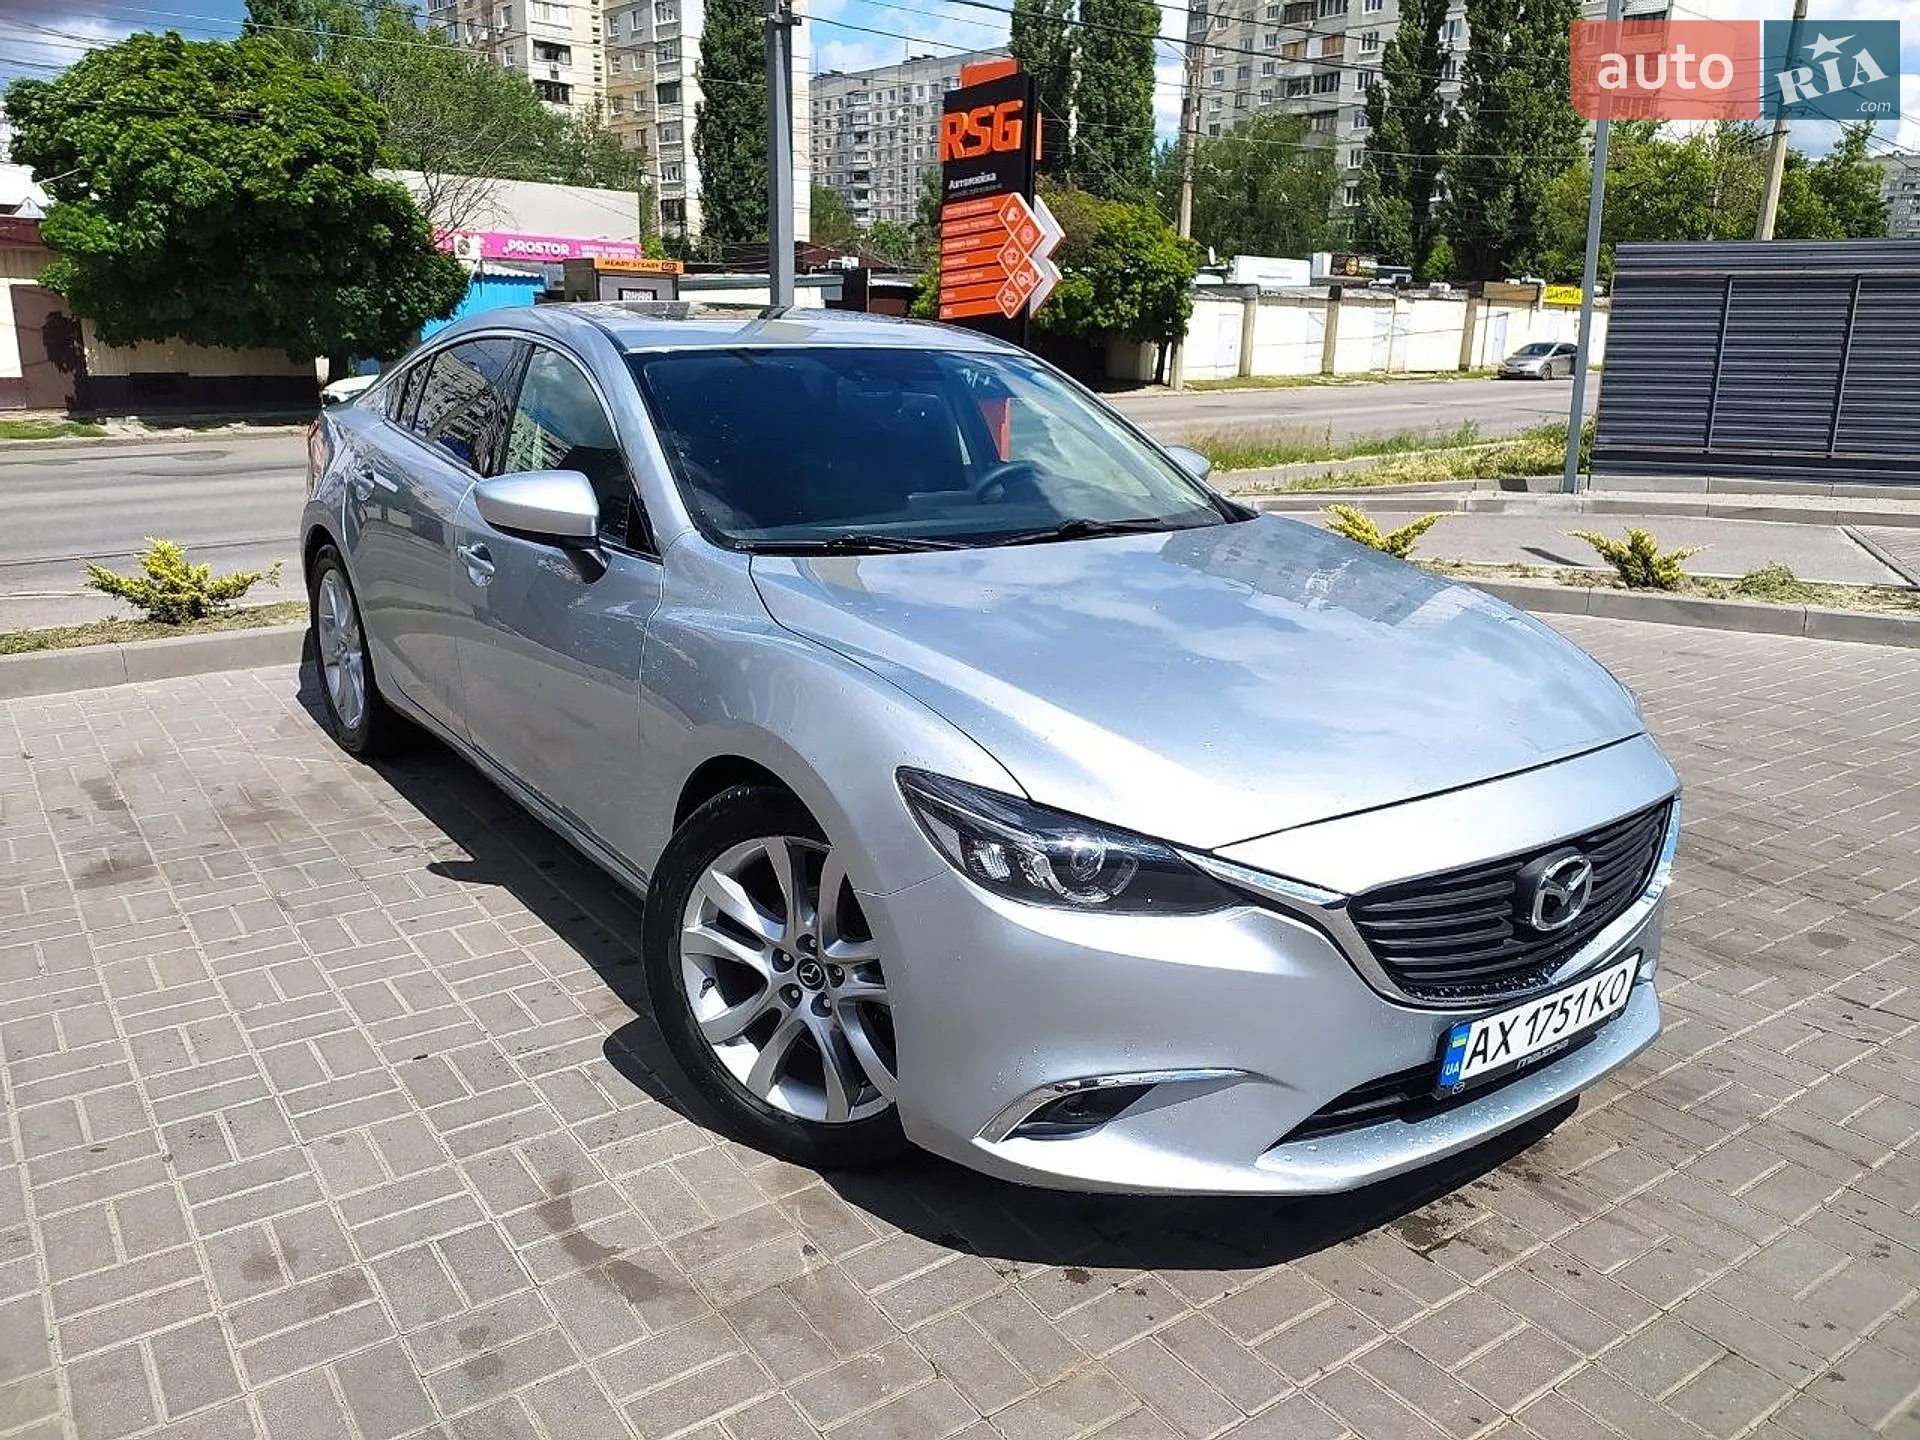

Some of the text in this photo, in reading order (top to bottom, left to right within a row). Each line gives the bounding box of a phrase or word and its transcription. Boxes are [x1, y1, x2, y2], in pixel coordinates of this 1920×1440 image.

[938, 100, 1024, 161] RSG
[507, 240, 570, 257] PROSTOR
[1465, 968, 1627, 1070] AX 1751 KO
[1444, 1064, 1460, 1077] UA
